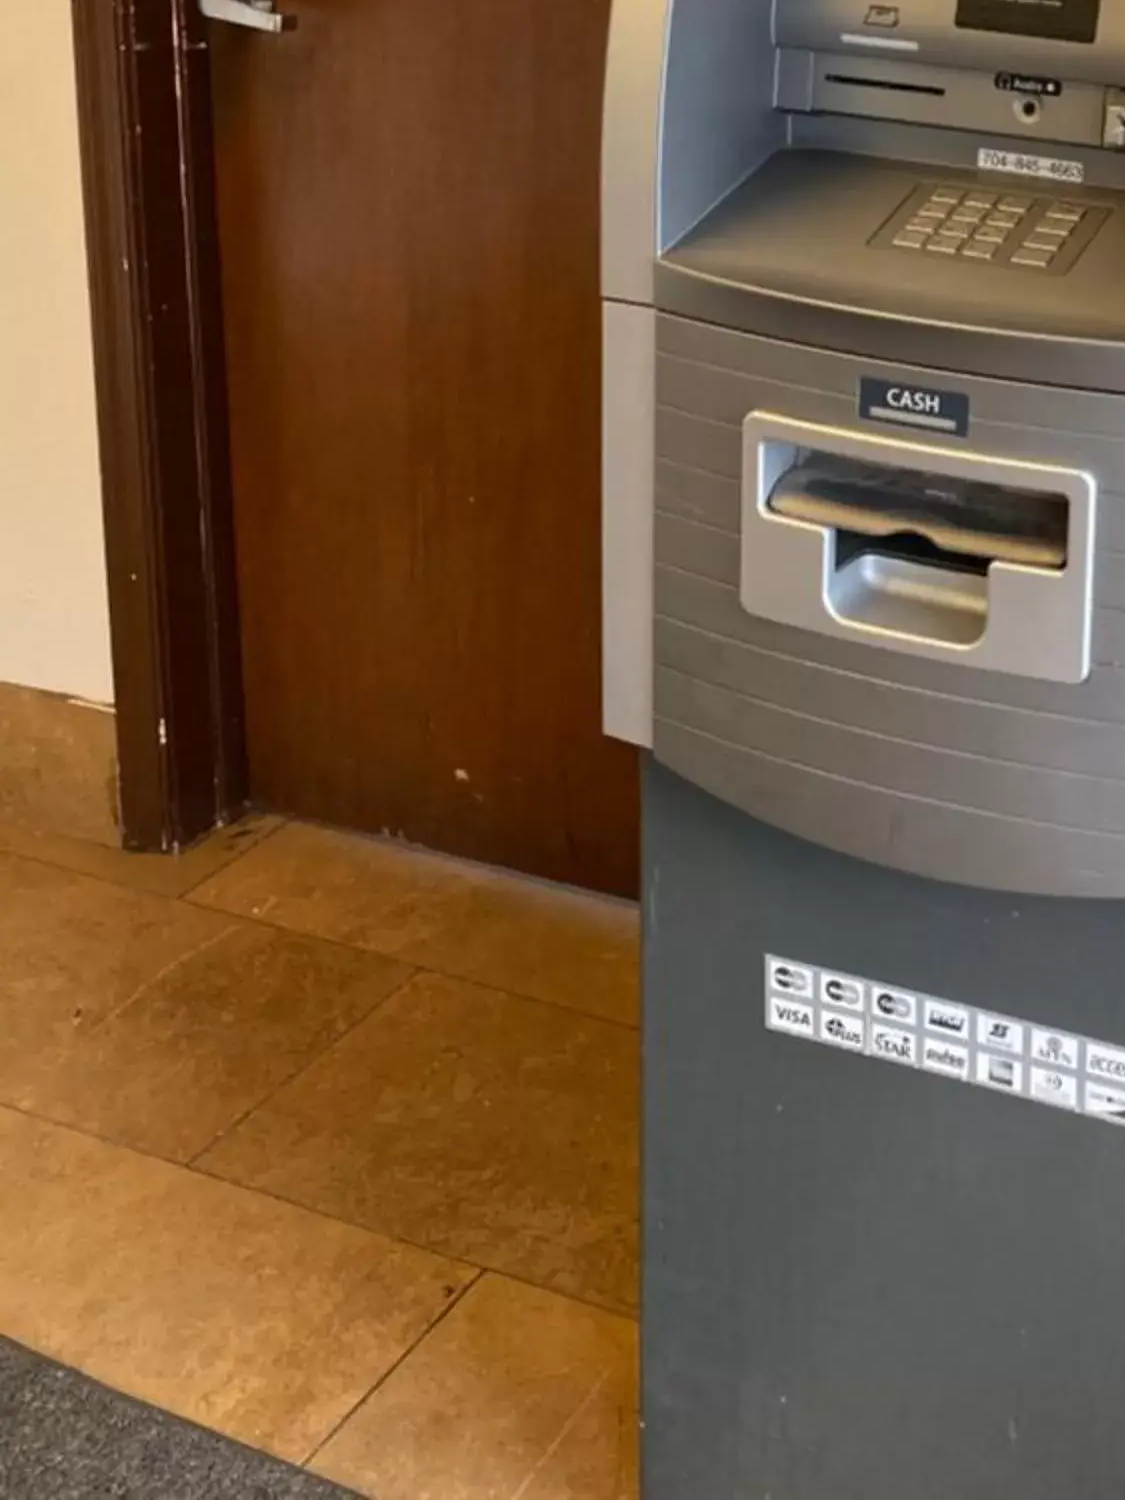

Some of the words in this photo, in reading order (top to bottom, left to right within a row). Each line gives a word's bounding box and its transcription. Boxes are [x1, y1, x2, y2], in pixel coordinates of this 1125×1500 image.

[886, 388, 940, 414] CASH
[775, 1004, 811, 1026] VISA
[834, 1029, 862, 1045] PLUS
